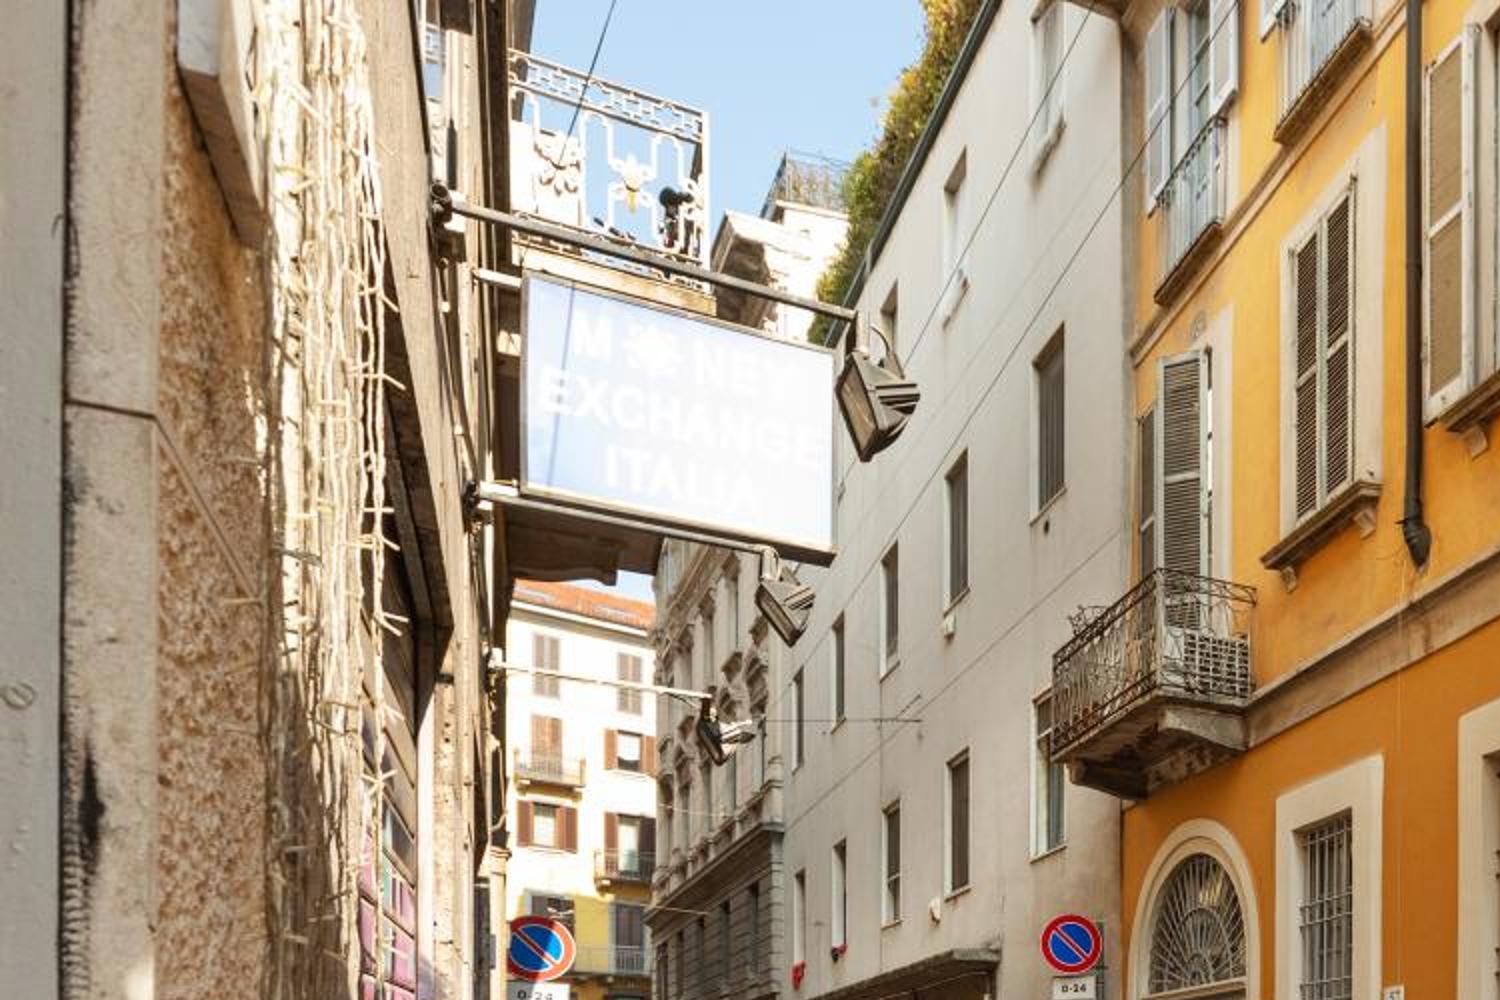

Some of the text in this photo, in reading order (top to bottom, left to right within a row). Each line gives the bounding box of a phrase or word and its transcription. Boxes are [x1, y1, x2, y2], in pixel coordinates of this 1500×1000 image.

[540, 368, 823, 472] EXCHANGE
[607, 446, 757, 516] ITALIA
[1061, 983, 1087, 993] 0-24
